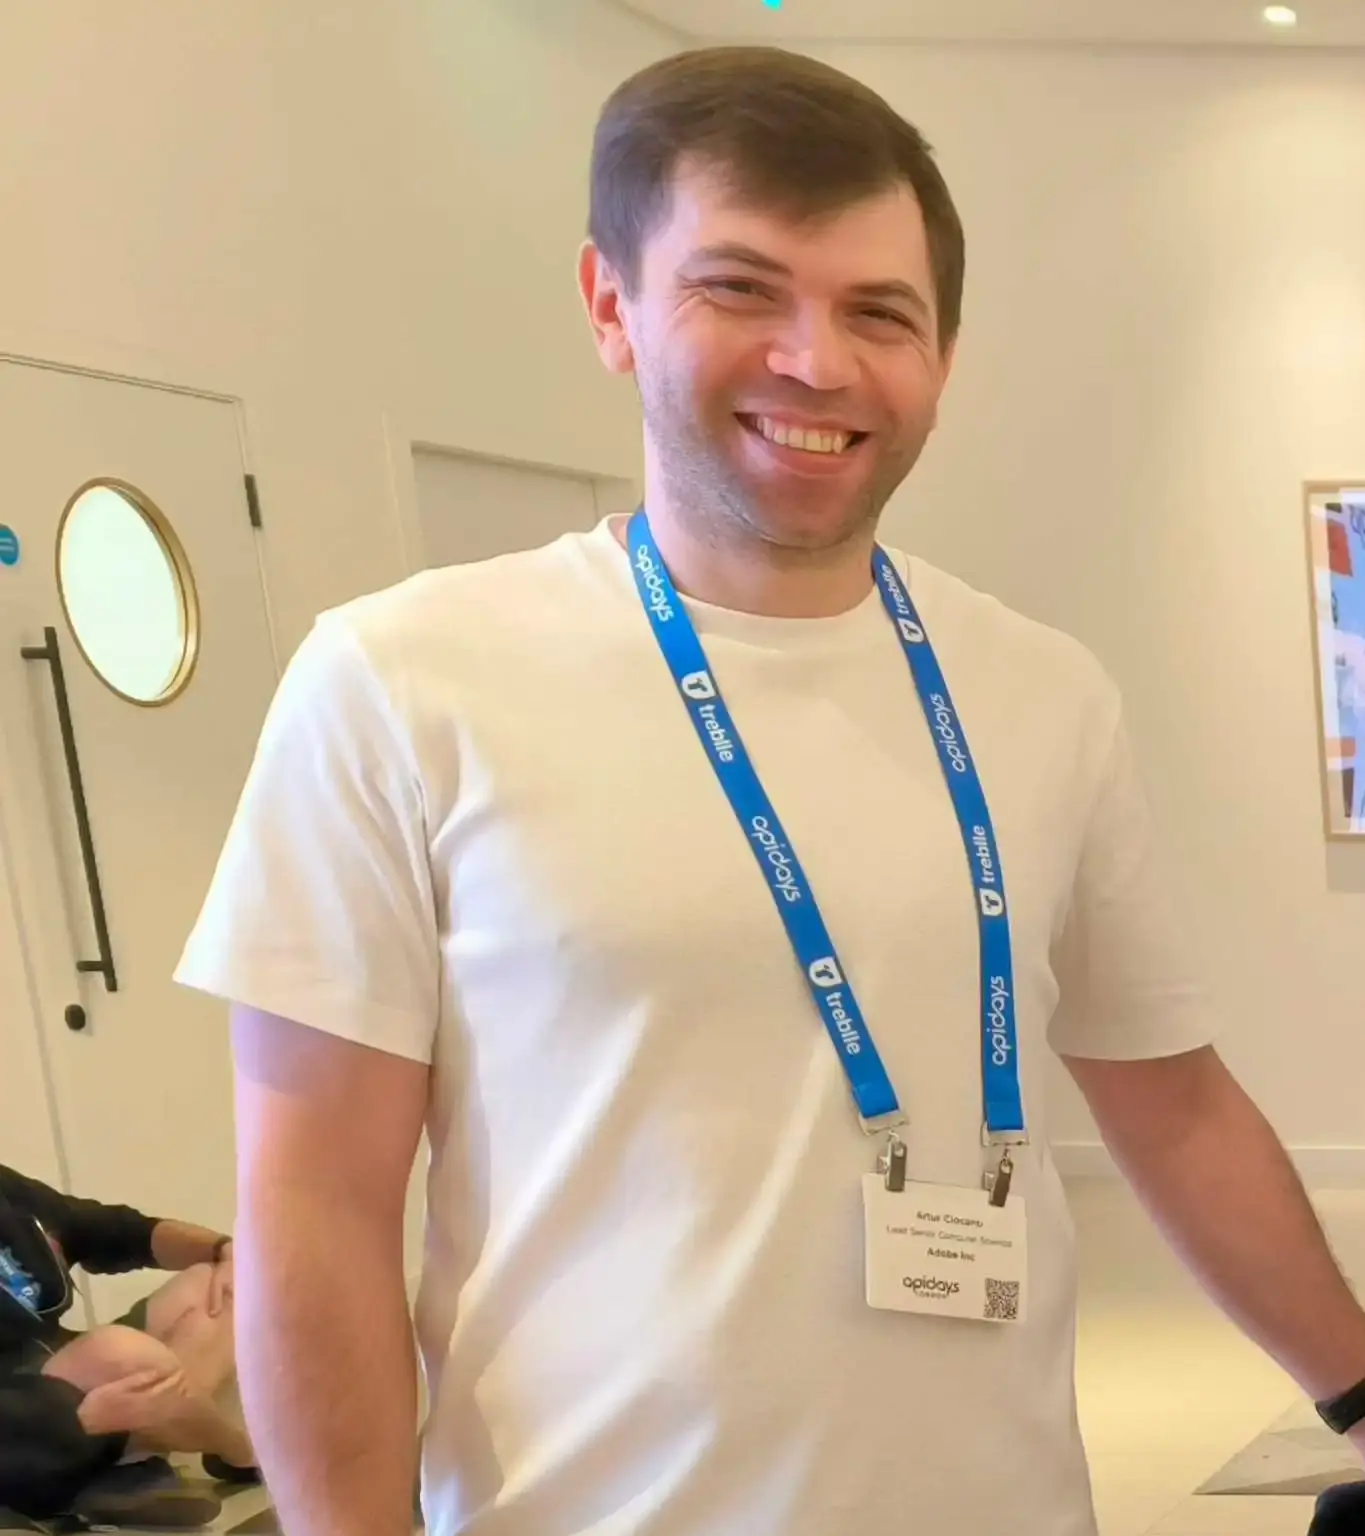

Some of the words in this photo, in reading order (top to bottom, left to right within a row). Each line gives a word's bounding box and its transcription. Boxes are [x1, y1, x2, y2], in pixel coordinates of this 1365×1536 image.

[637, 544, 674, 622] apidays
[881, 564, 909, 614] treblle
[698, 703, 733, 763] treblle
[929, 693, 966, 772] apidays
[752, 815, 801, 901] apidays
[972, 825, 995, 883] treblle
[826, 991, 861, 1056] treblle
[991, 975, 1009, 1065] apidays
[903, 1276, 960, 1295] apidays
